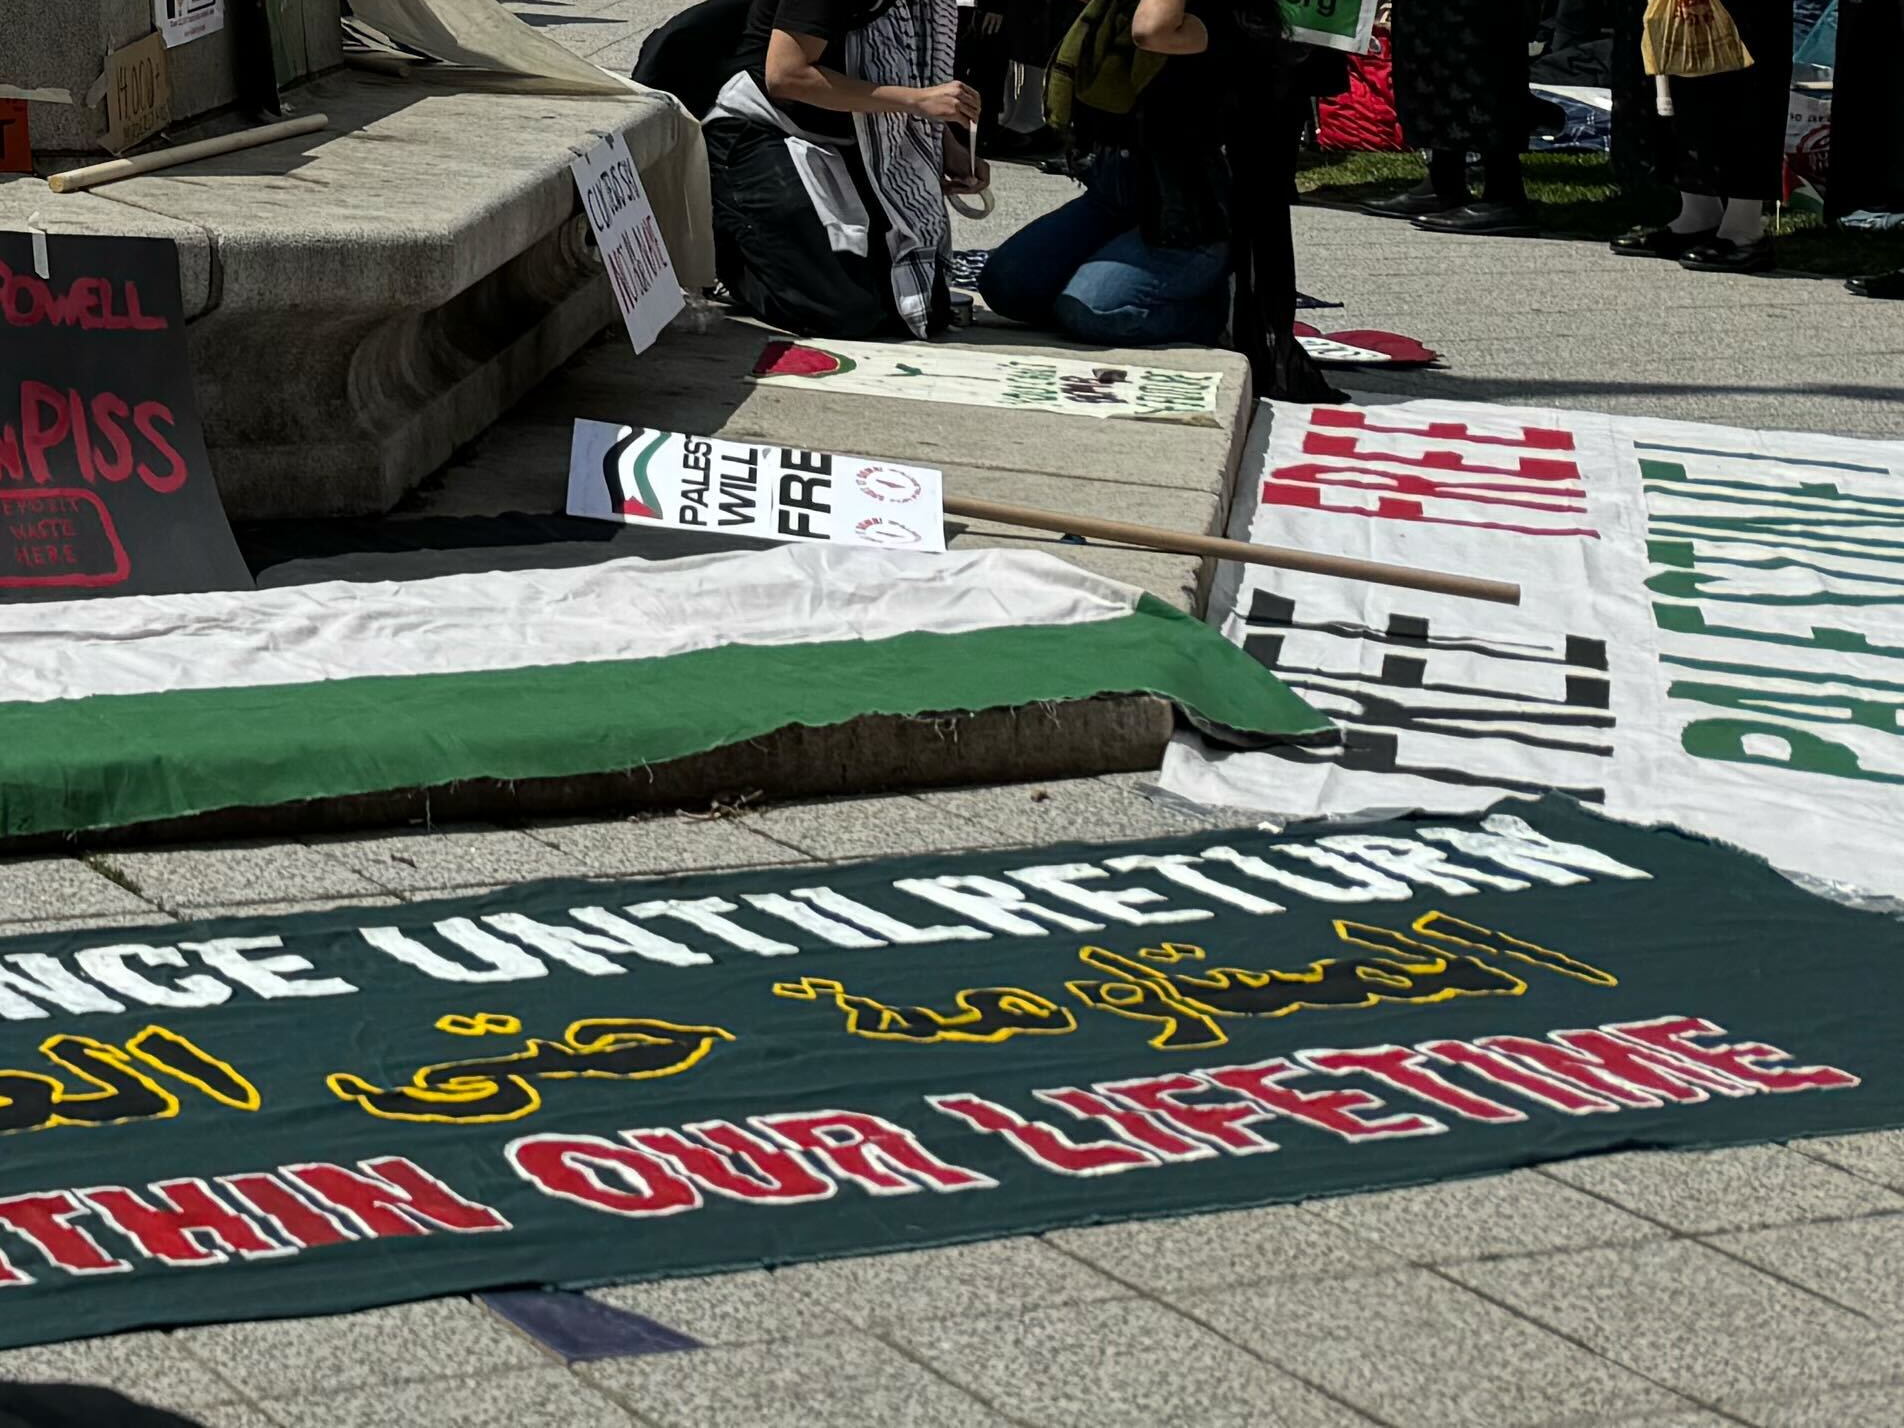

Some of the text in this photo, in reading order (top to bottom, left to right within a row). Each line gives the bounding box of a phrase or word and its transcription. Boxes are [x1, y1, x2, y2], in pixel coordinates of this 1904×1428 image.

[20, 379, 188, 494] PISS
[679, 433, 712, 526] PALES
[717, 448, 758, 526] WILL
[1262, 407, 1602, 541] FREE
[9, 520, 78, 541] WASTE
[15, 546, 79, 569] HERE
[1242, 587, 1617, 806] FREE
[357, 885, 995, 987] UNTIL
[892, 811, 1654, 938] RETURN
[503, 1109, 998, 1220] OUR
[931, 1013, 1861, 1179] LIFETIME
